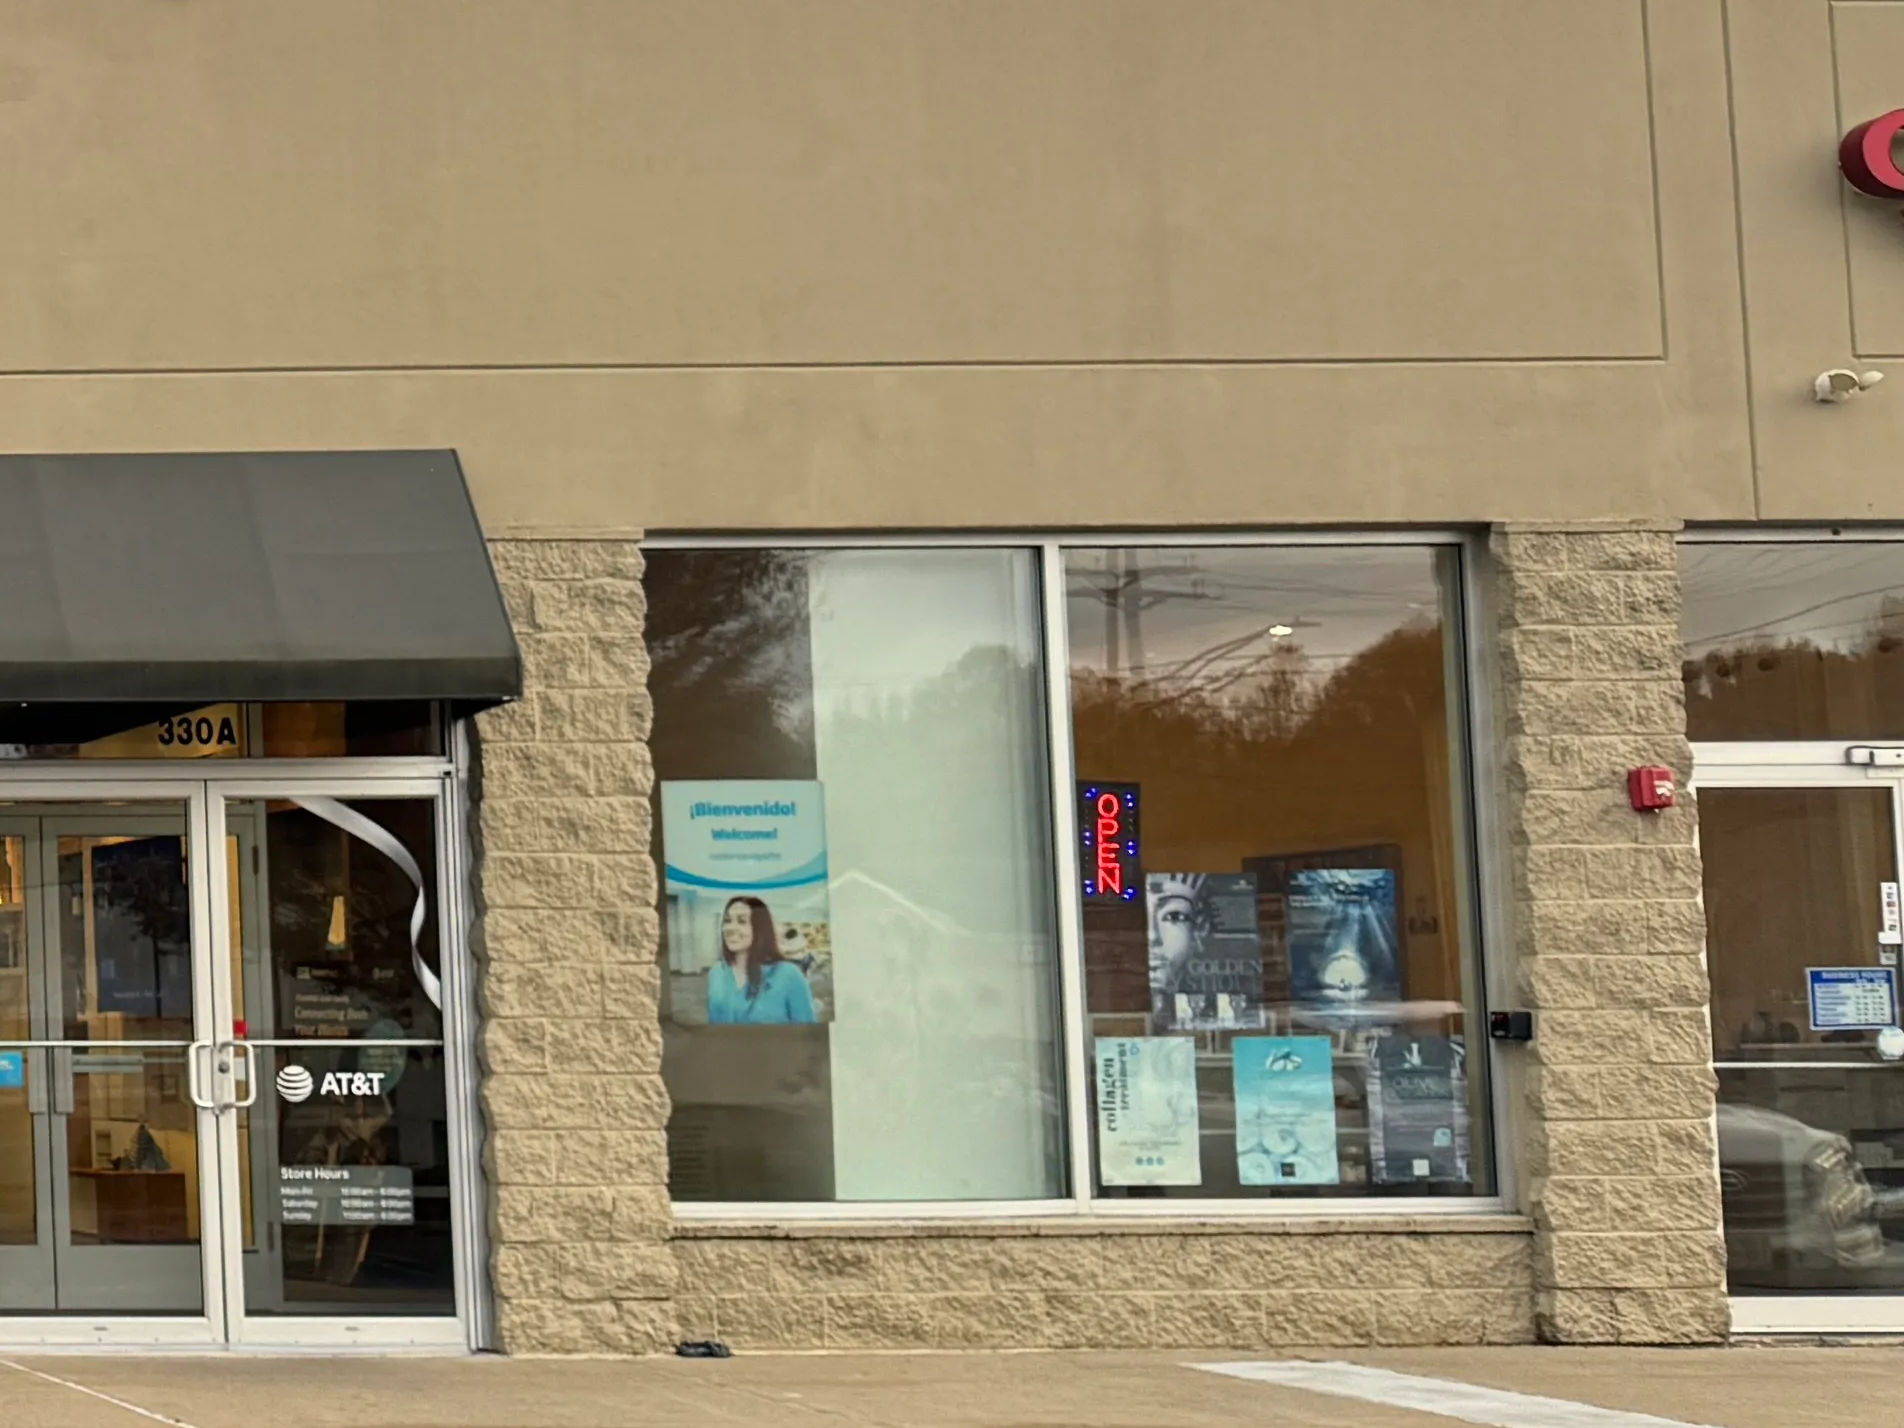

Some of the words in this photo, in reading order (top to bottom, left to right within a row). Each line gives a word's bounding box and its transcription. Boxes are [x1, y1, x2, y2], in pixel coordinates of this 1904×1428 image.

[158, 717, 237, 746] 330A
[690, 800, 796, 820] ¡Bienvenido!
[1097, 793, 1120, 895] OPEN
[320, 1072, 385, 1095] AT&T
[1101, 1057, 1117, 1132] collagen
[281, 1167, 312, 1180] Store
[314, 1167, 349, 1180] Hours
